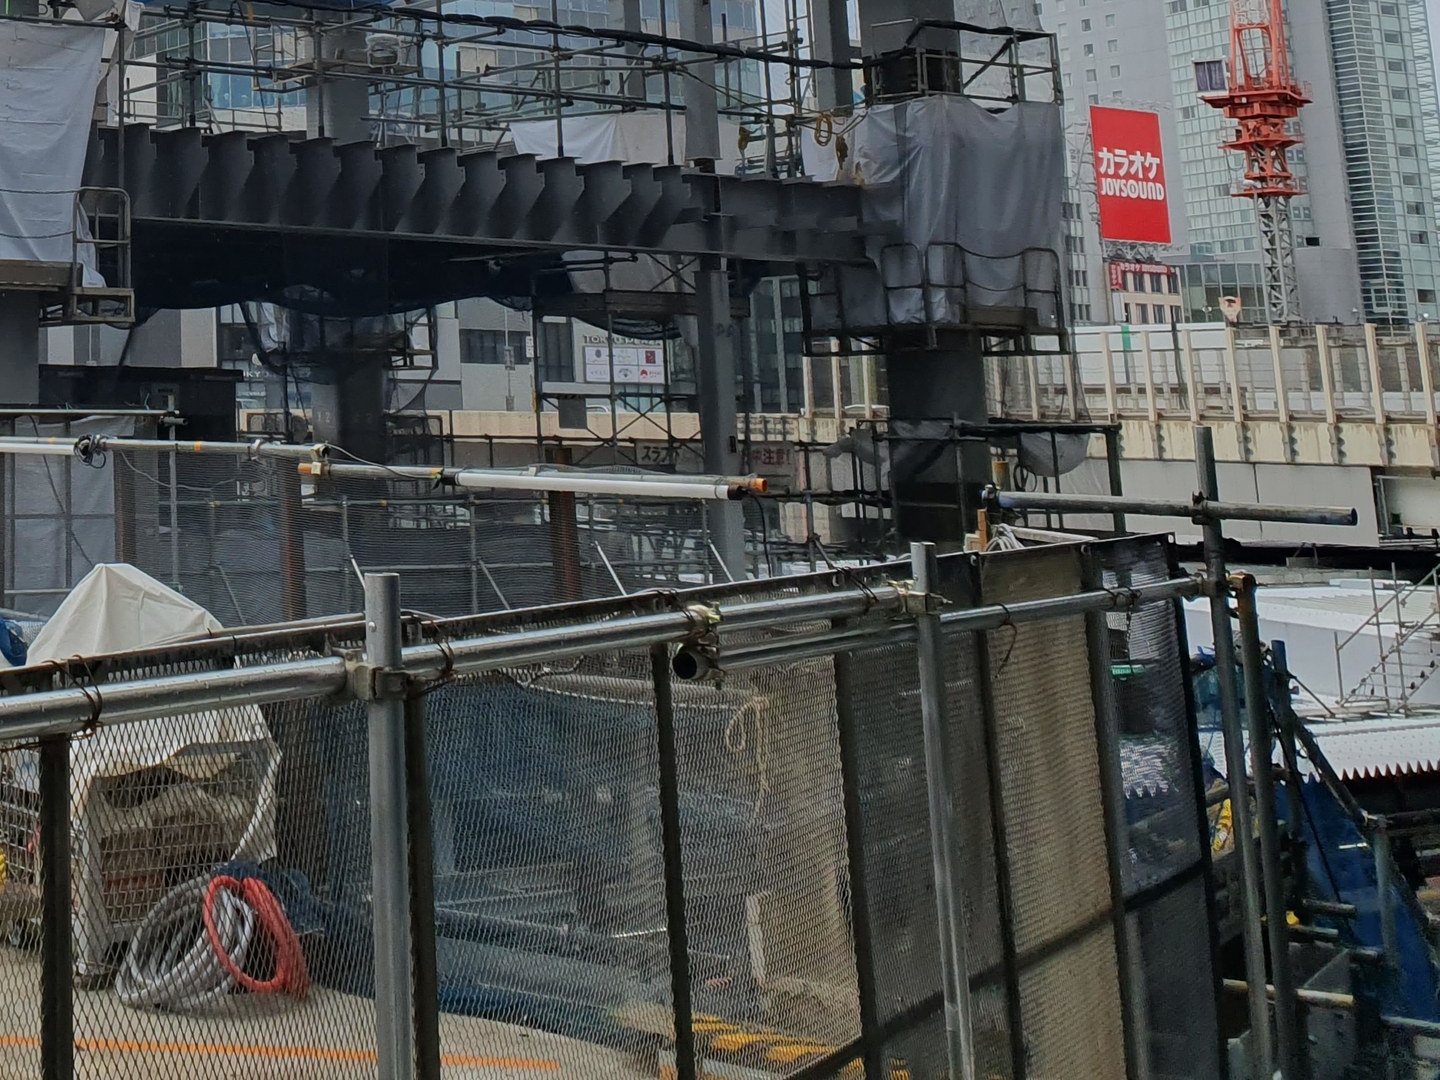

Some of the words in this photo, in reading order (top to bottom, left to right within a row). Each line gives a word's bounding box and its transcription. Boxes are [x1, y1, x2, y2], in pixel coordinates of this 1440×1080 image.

[1098, 147, 1160, 179] カラオケ
[1101, 178, 1164, 201] JOYSOUND
